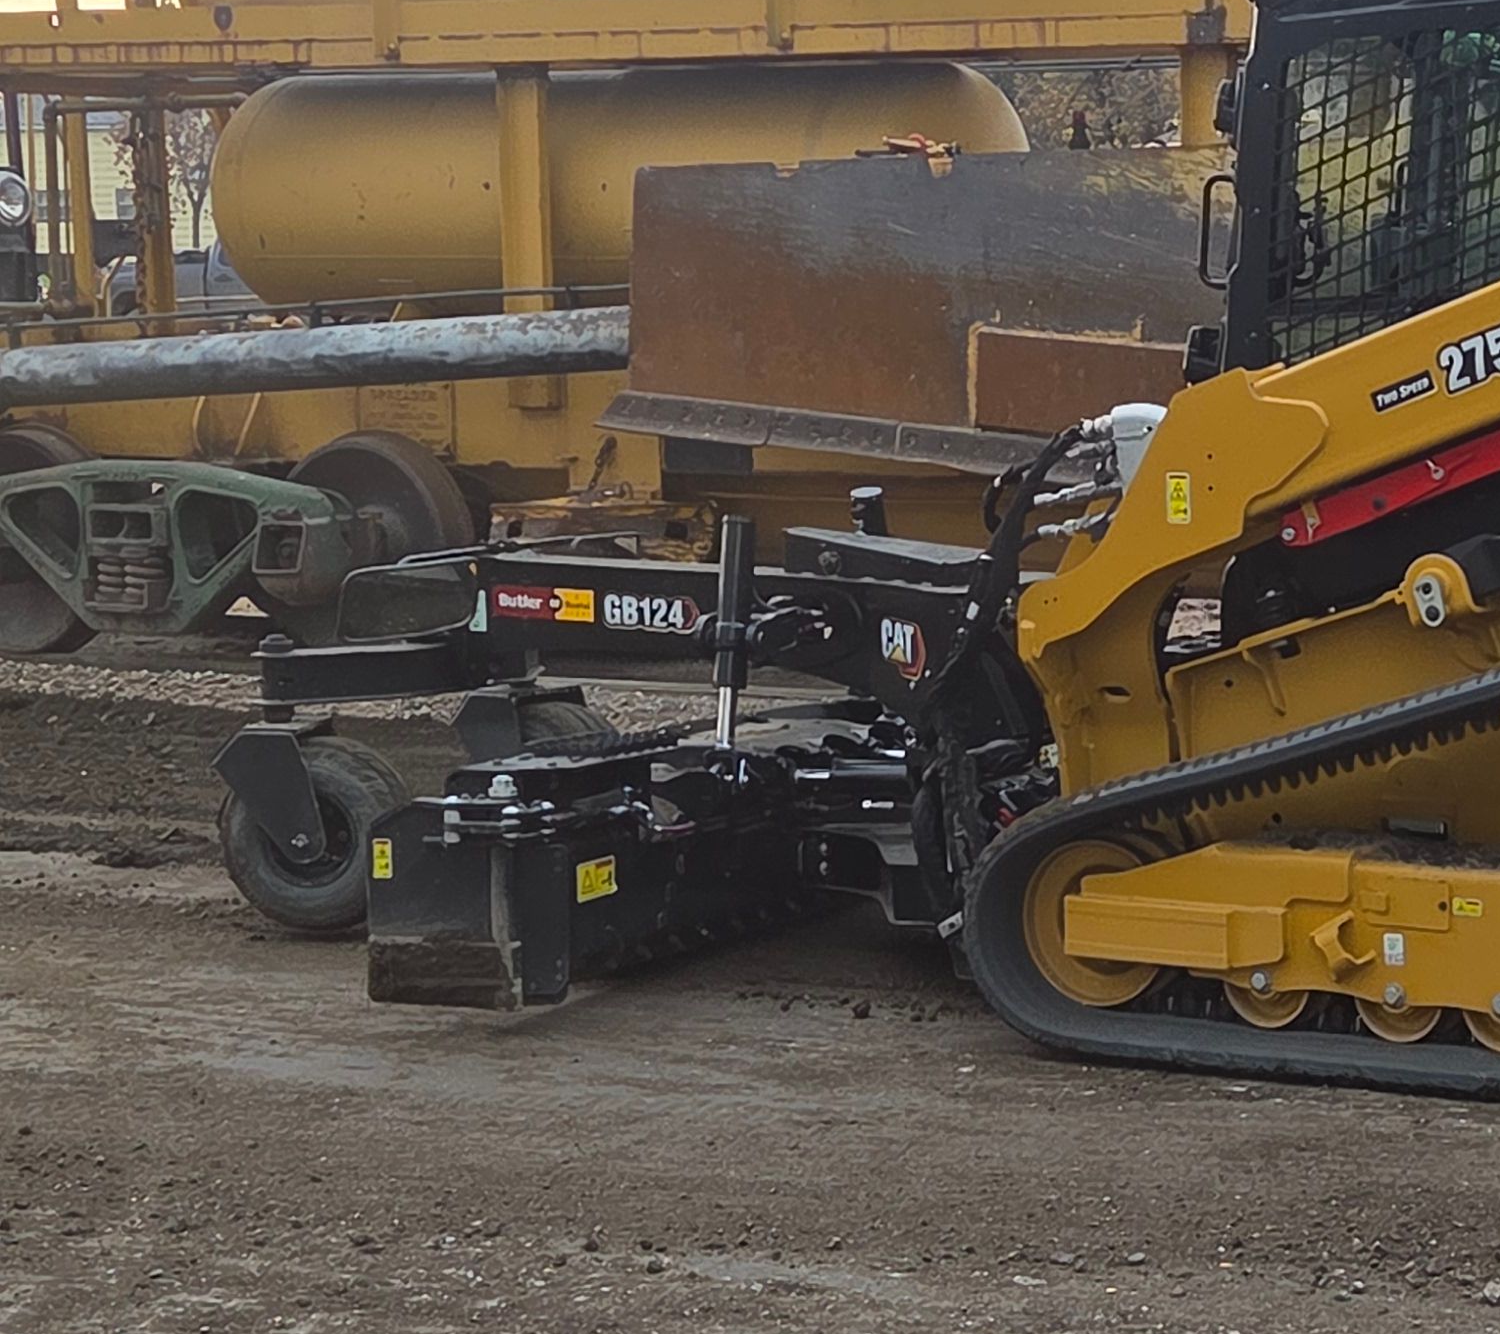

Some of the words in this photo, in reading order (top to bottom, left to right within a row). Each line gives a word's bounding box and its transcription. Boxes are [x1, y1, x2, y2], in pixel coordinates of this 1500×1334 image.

[498, 592, 543, 610] Butler
[603, 593, 685, 629] GB124
[880, 618, 915, 664] CAT
